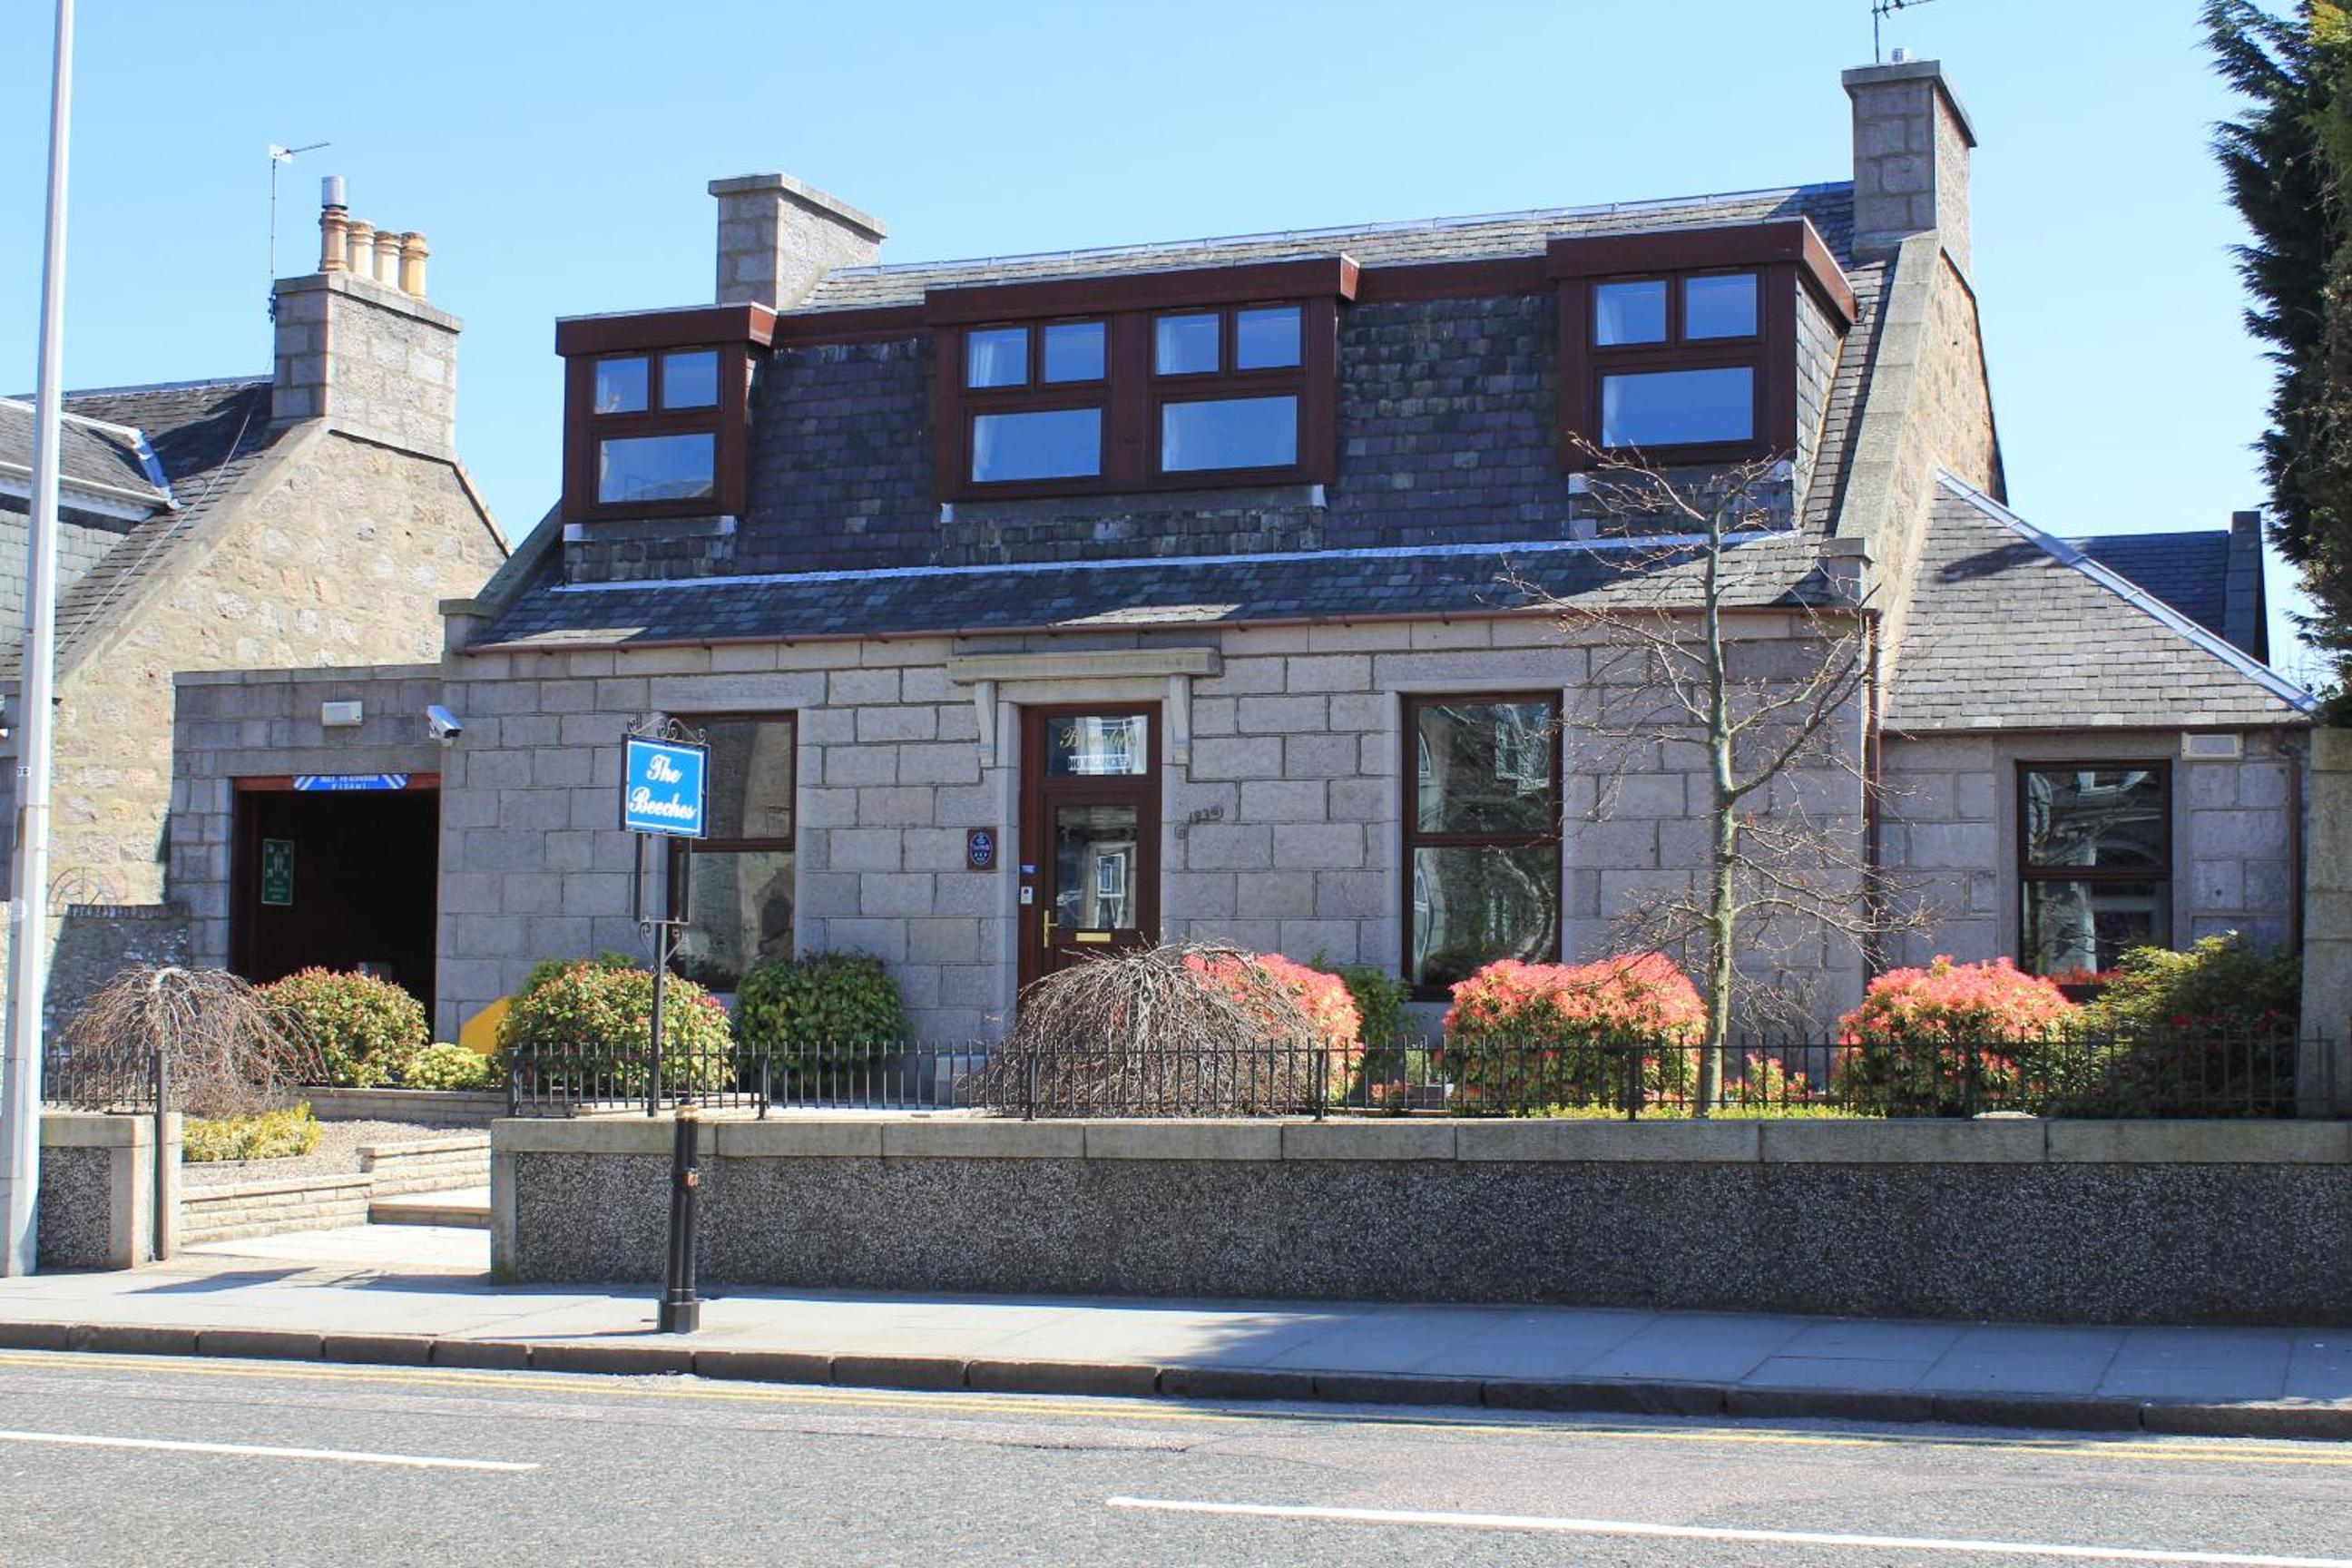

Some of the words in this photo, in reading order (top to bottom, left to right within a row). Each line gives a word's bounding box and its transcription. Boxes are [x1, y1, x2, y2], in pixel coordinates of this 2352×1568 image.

[646, 753, 682, 783] The
[1068, 756, 1081, 769] NO
[630, 786, 697, 819] Beeches
